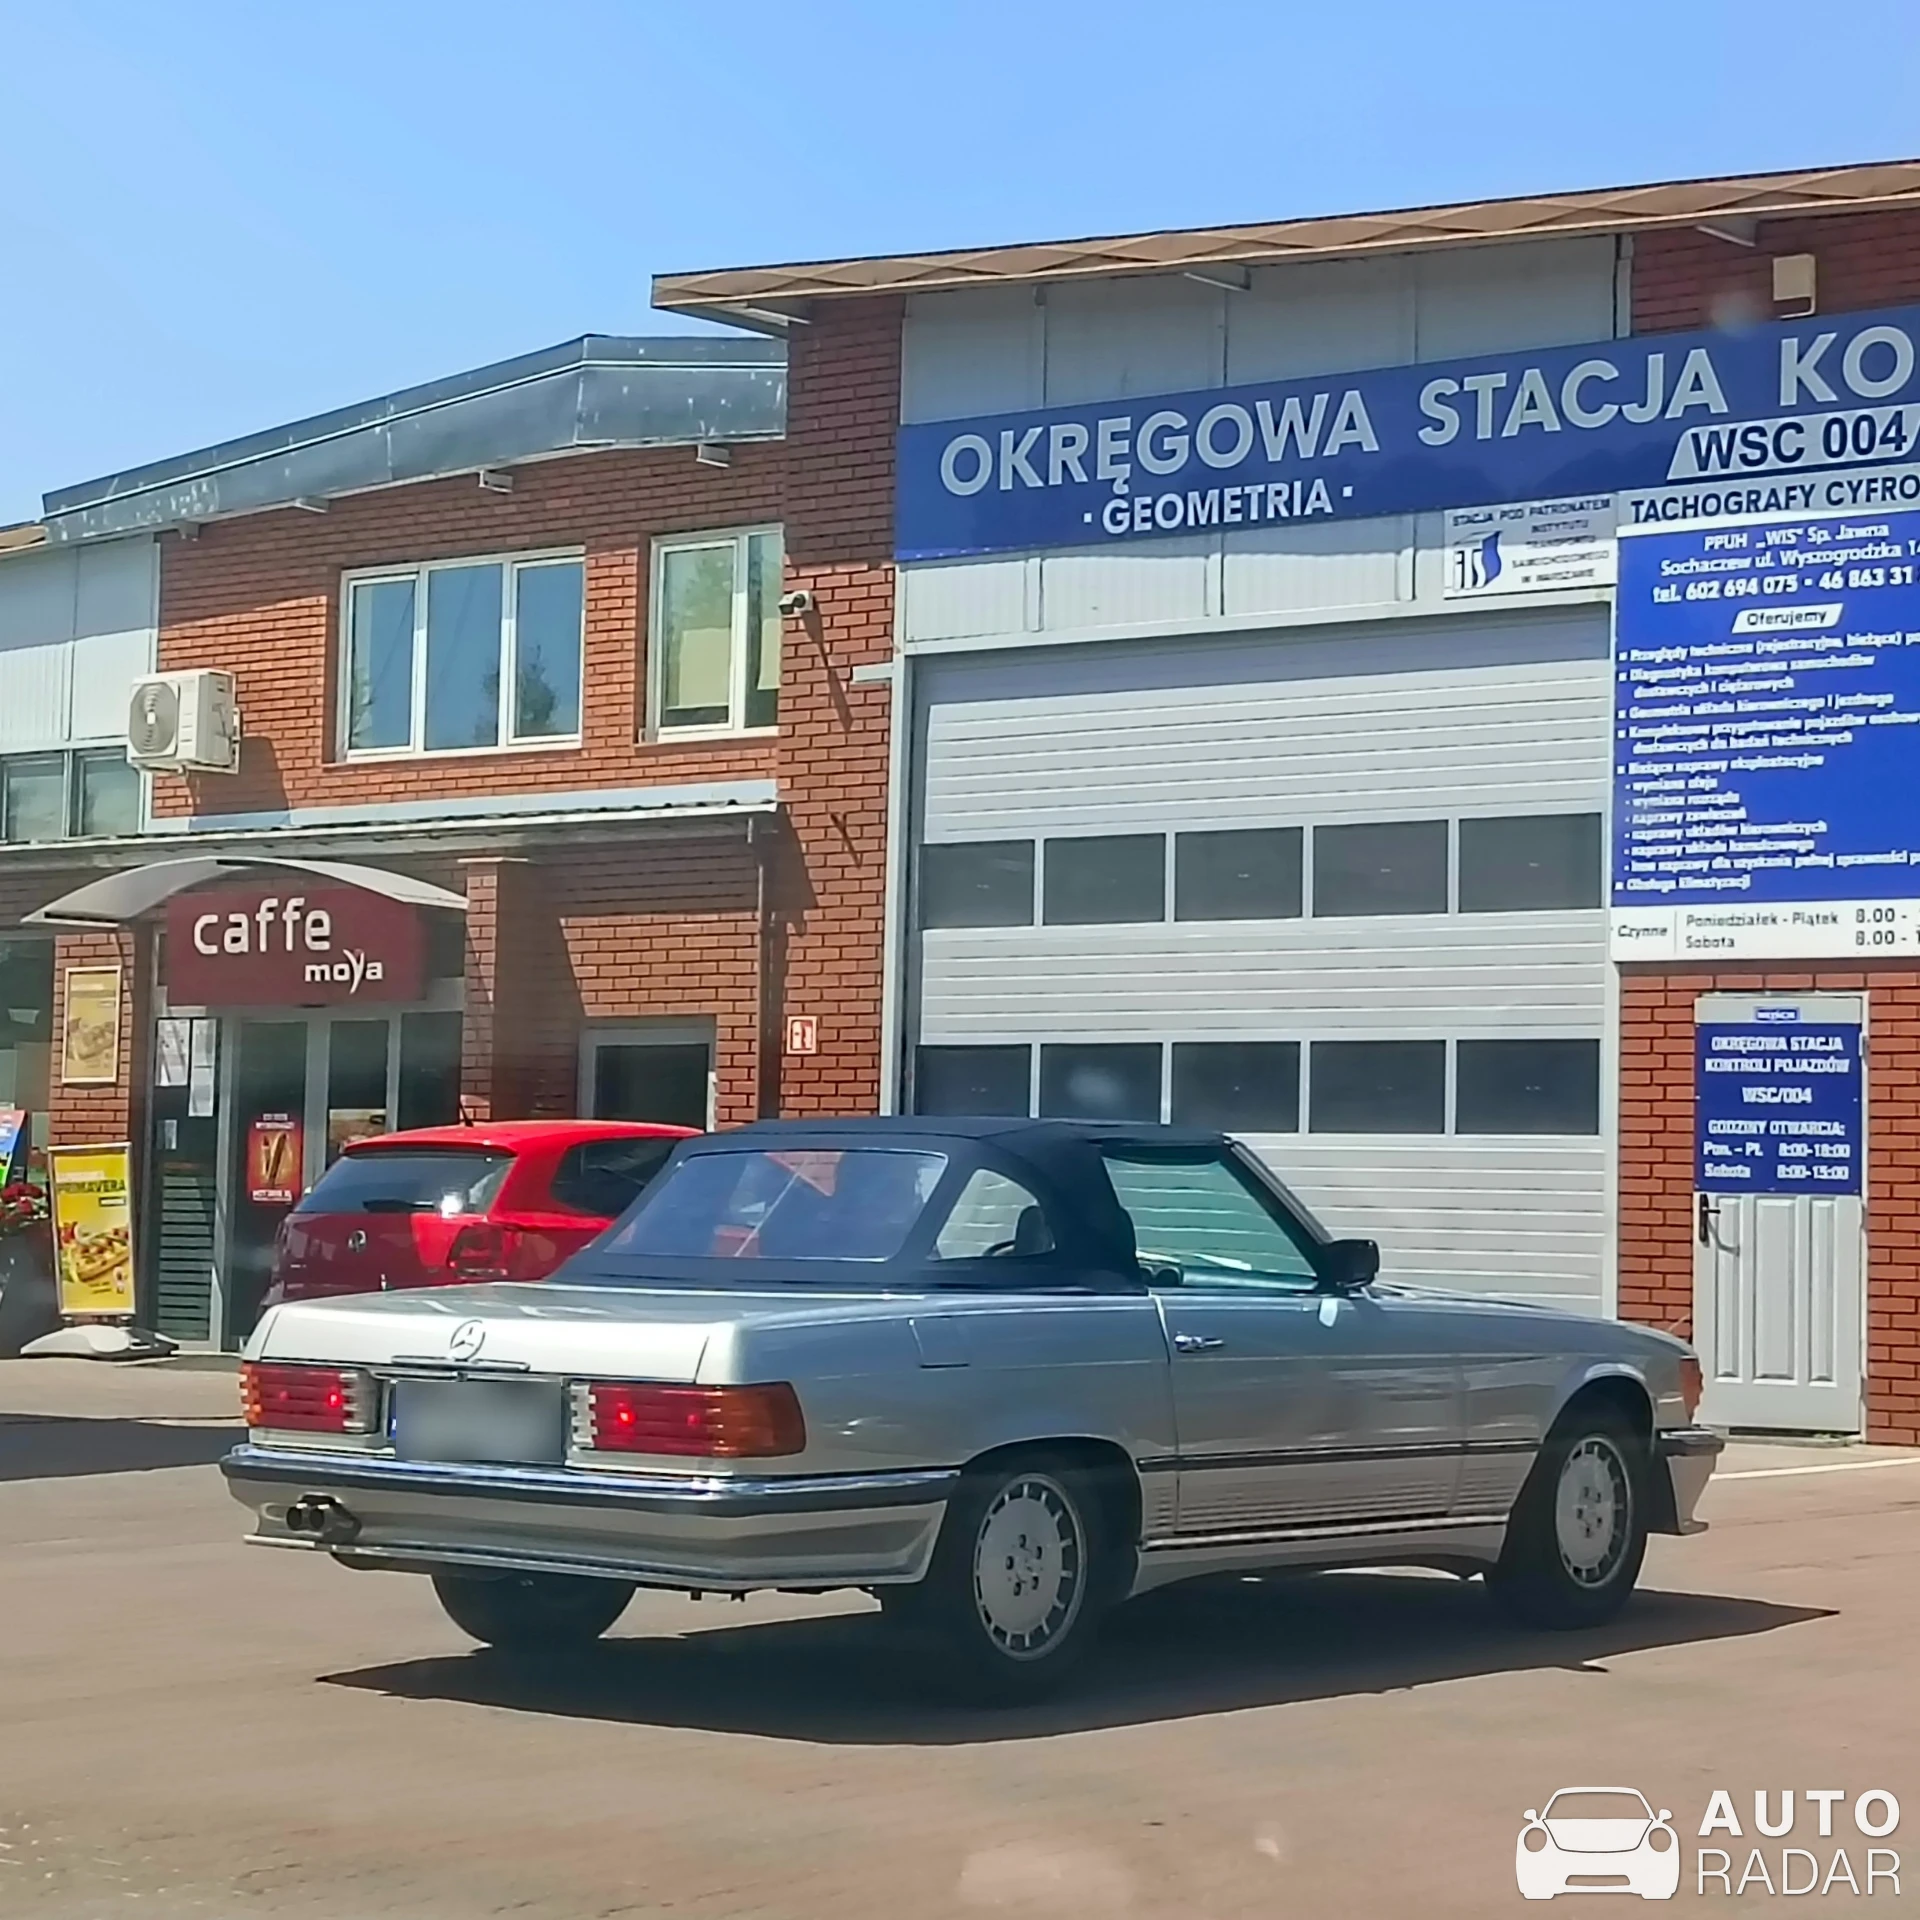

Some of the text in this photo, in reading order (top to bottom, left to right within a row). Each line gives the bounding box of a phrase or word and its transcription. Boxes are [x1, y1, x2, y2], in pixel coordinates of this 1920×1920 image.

[940, 326, 1914, 496] OKRĘGOWA STACJA KO
[1691, 410, 1908, 472] WSC 004
[1102, 478, 1334, 535] GEOMETRIA
[1453, 498, 1611, 526] STACJA POD PATRONATEM
[1631, 474, 1920, 524] TACHOGRAFY CYFRO
[1704, 533, 1748, 551] PPUH
[1807, 526, 1831, 545] Sp.
[1755, 551, 1775, 567] ul.
[1653, 566, 1913, 603] tel. 602 694 075 46 863 31
[1747, 611, 1827, 626] Oferujemy
[193, 897, 331, 955] caffe
[1686, 911, 1777, 927] Poniedziałek
[1792, 910, 1839, 927] Piątek
[1856, 908, 1895, 923] 8.00
[1618, 925, 1668, 939] Czynne
[1686, 936, 1735, 948] Sobota
[1856, 930, 1895, 946] 8.00
[1790, 1036, 1844, 1051] STACJA
